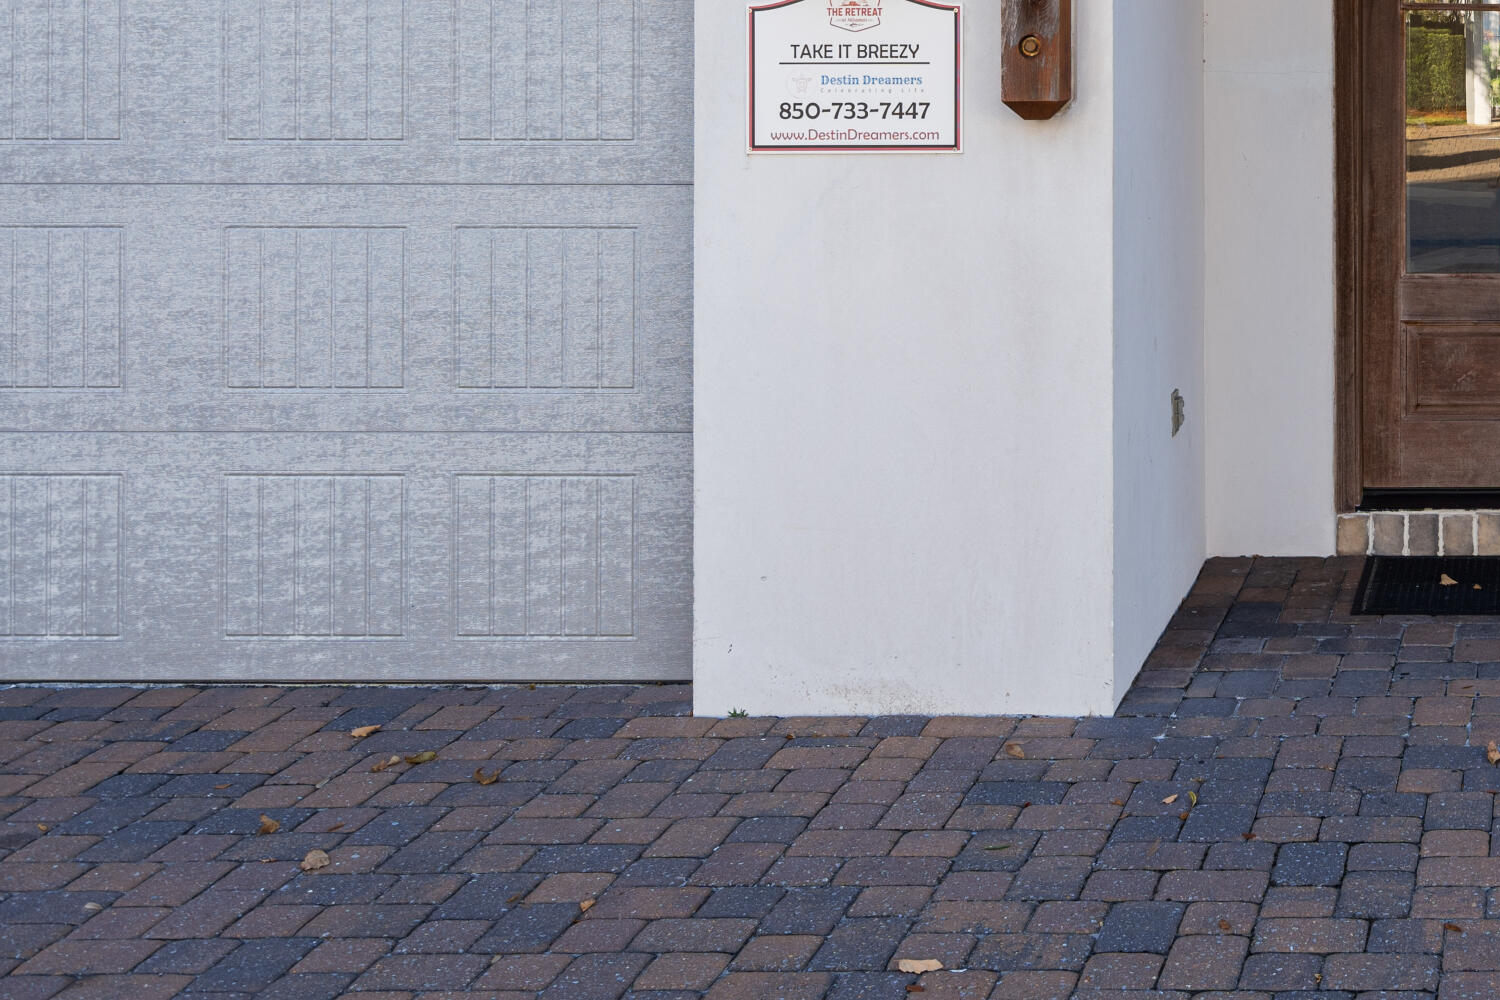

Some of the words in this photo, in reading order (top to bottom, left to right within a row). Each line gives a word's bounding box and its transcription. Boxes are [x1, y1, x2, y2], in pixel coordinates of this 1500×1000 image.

[827, 7, 844, 17] THE
[845, 7, 882, 17] RETREAT
[790, 44, 833, 59] TAKE
[838, 44, 852, 59] IT
[857, 44, 919, 59] BREEZY
[821, 74, 859, 85] Destin
[863, 75, 922, 85] Dreamers
[779, 102, 930, 120] 850-733-7447
[770, 128, 939, 141] www.DestinDreamers.com
